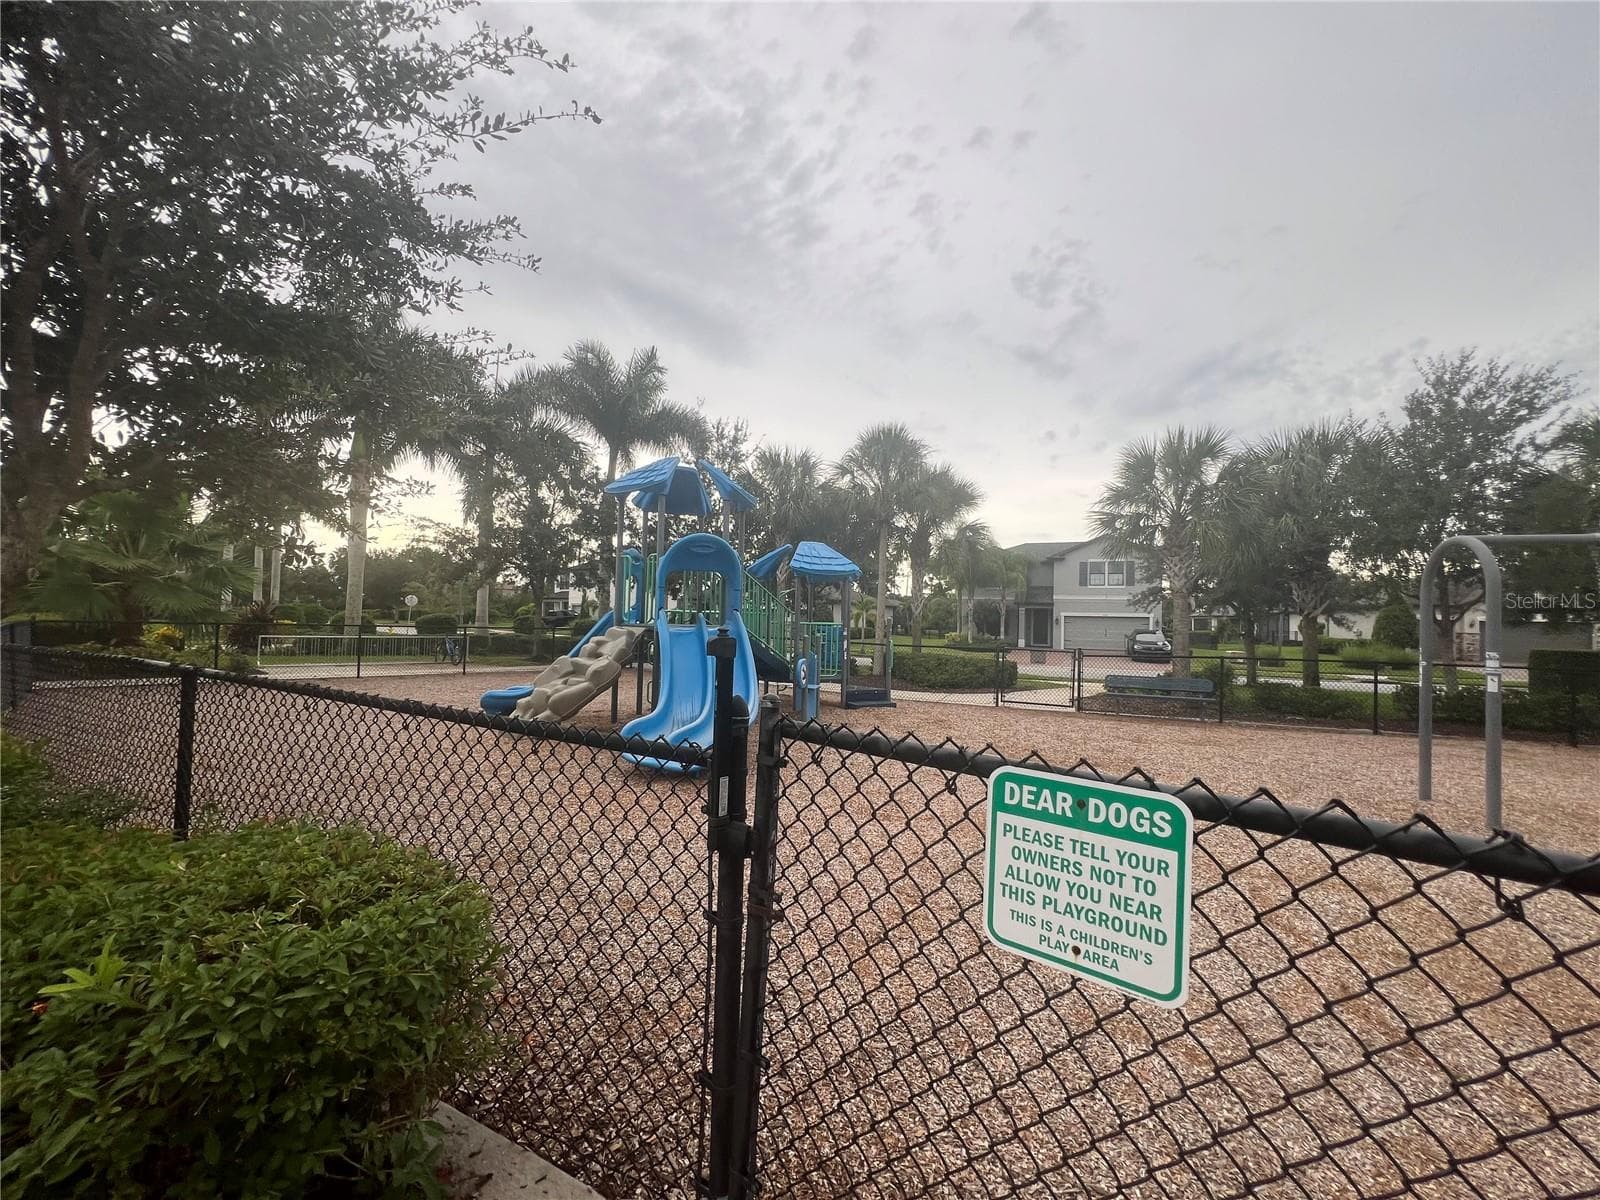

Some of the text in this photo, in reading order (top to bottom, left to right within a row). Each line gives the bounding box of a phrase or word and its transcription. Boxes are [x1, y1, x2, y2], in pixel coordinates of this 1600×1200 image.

[1004, 782, 1172, 838] DEAR DOGS
[1003, 823, 1170, 877] PLEASE TELL YOUR
[1011, 846, 1156, 897] OWNERS NOT TO
[1000, 883, 1168, 946] THIS PLAYGROUND
[1005, 865, 1162, 922] ALLOW YOU NEAR
[1009, 909, 1153, 965] THIS IS A CHILDREN'S
[1039, 935, 1119, 971] PLAY AREA
